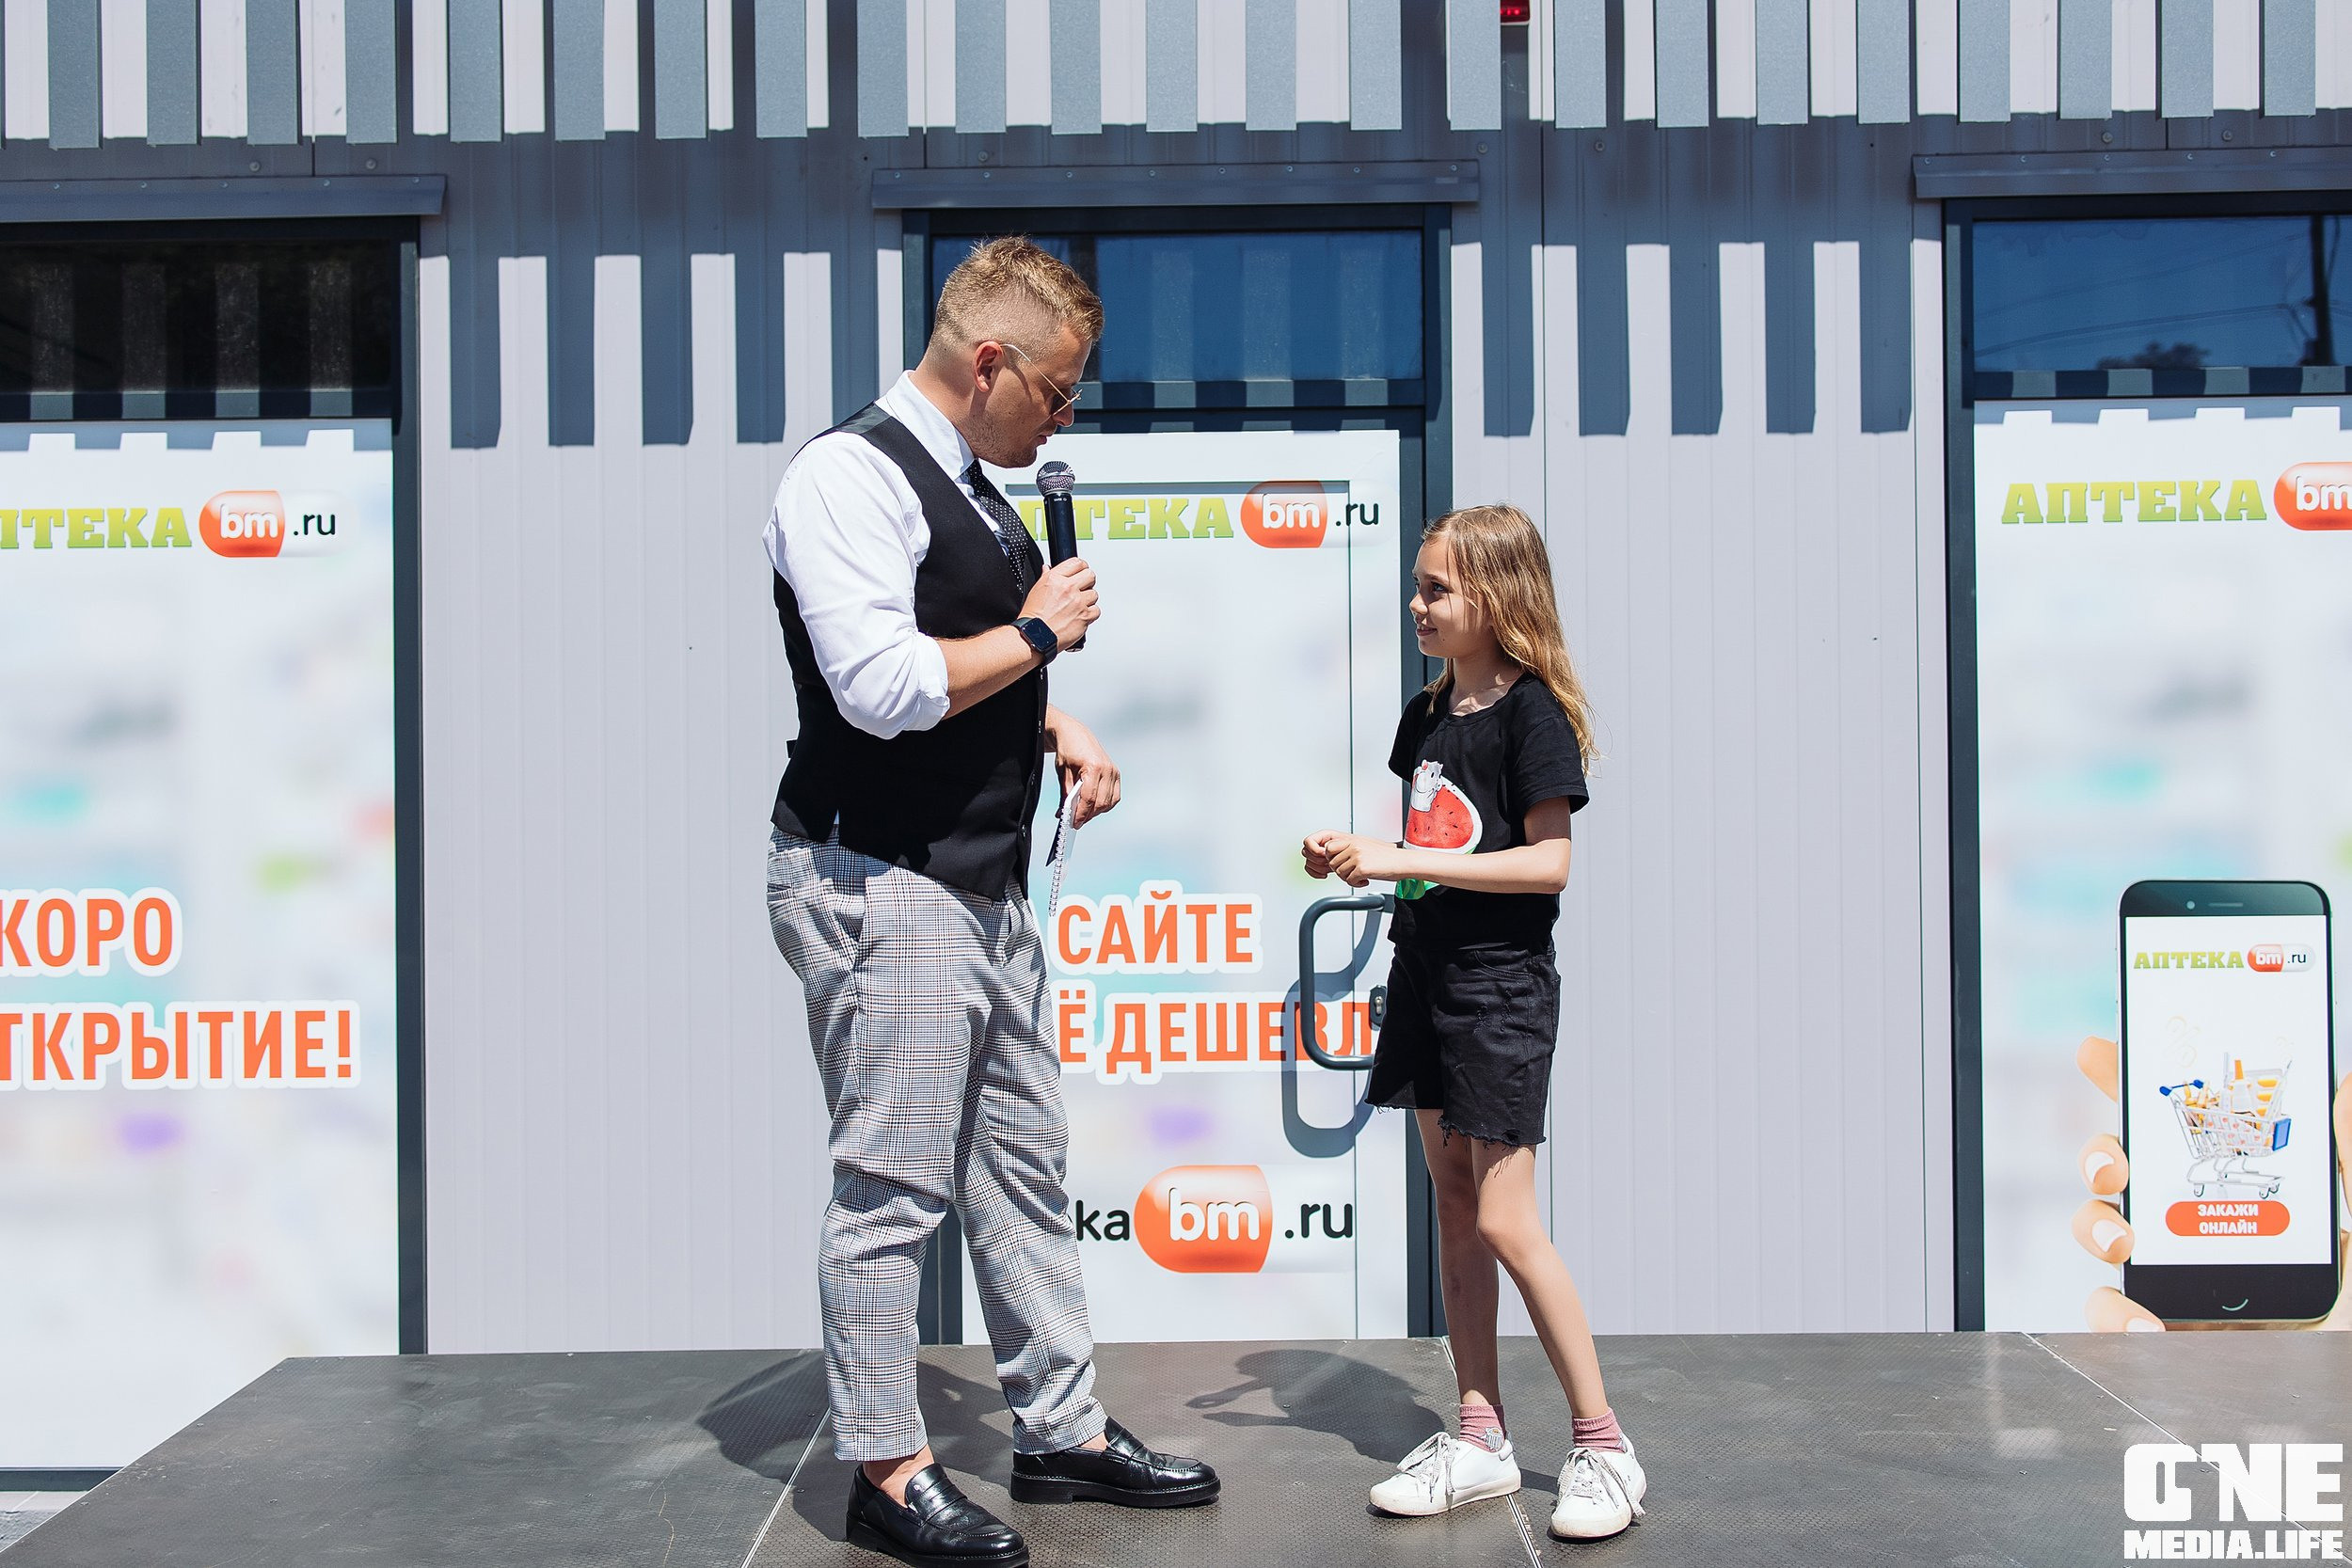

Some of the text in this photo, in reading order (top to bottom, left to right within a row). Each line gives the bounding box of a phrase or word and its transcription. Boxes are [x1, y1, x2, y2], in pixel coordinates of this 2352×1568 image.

[2001, 480, 2267, 524] АПТЕКА
[0, 897, 173, 967] КОРО
[1057, 890, 1253, 965] САЙТЕ
[2134, 951, 2245, 969] АПТЕКА
[0, 1010, 352, 1081] ТКРЫТИЕ!
[1067, 1199, 1130, 1241] ka
[2198, 1204, 2259, 1217] ЗАКАЖИ
[2199, 1219, 2258, 1234] ОНЛАЙН
